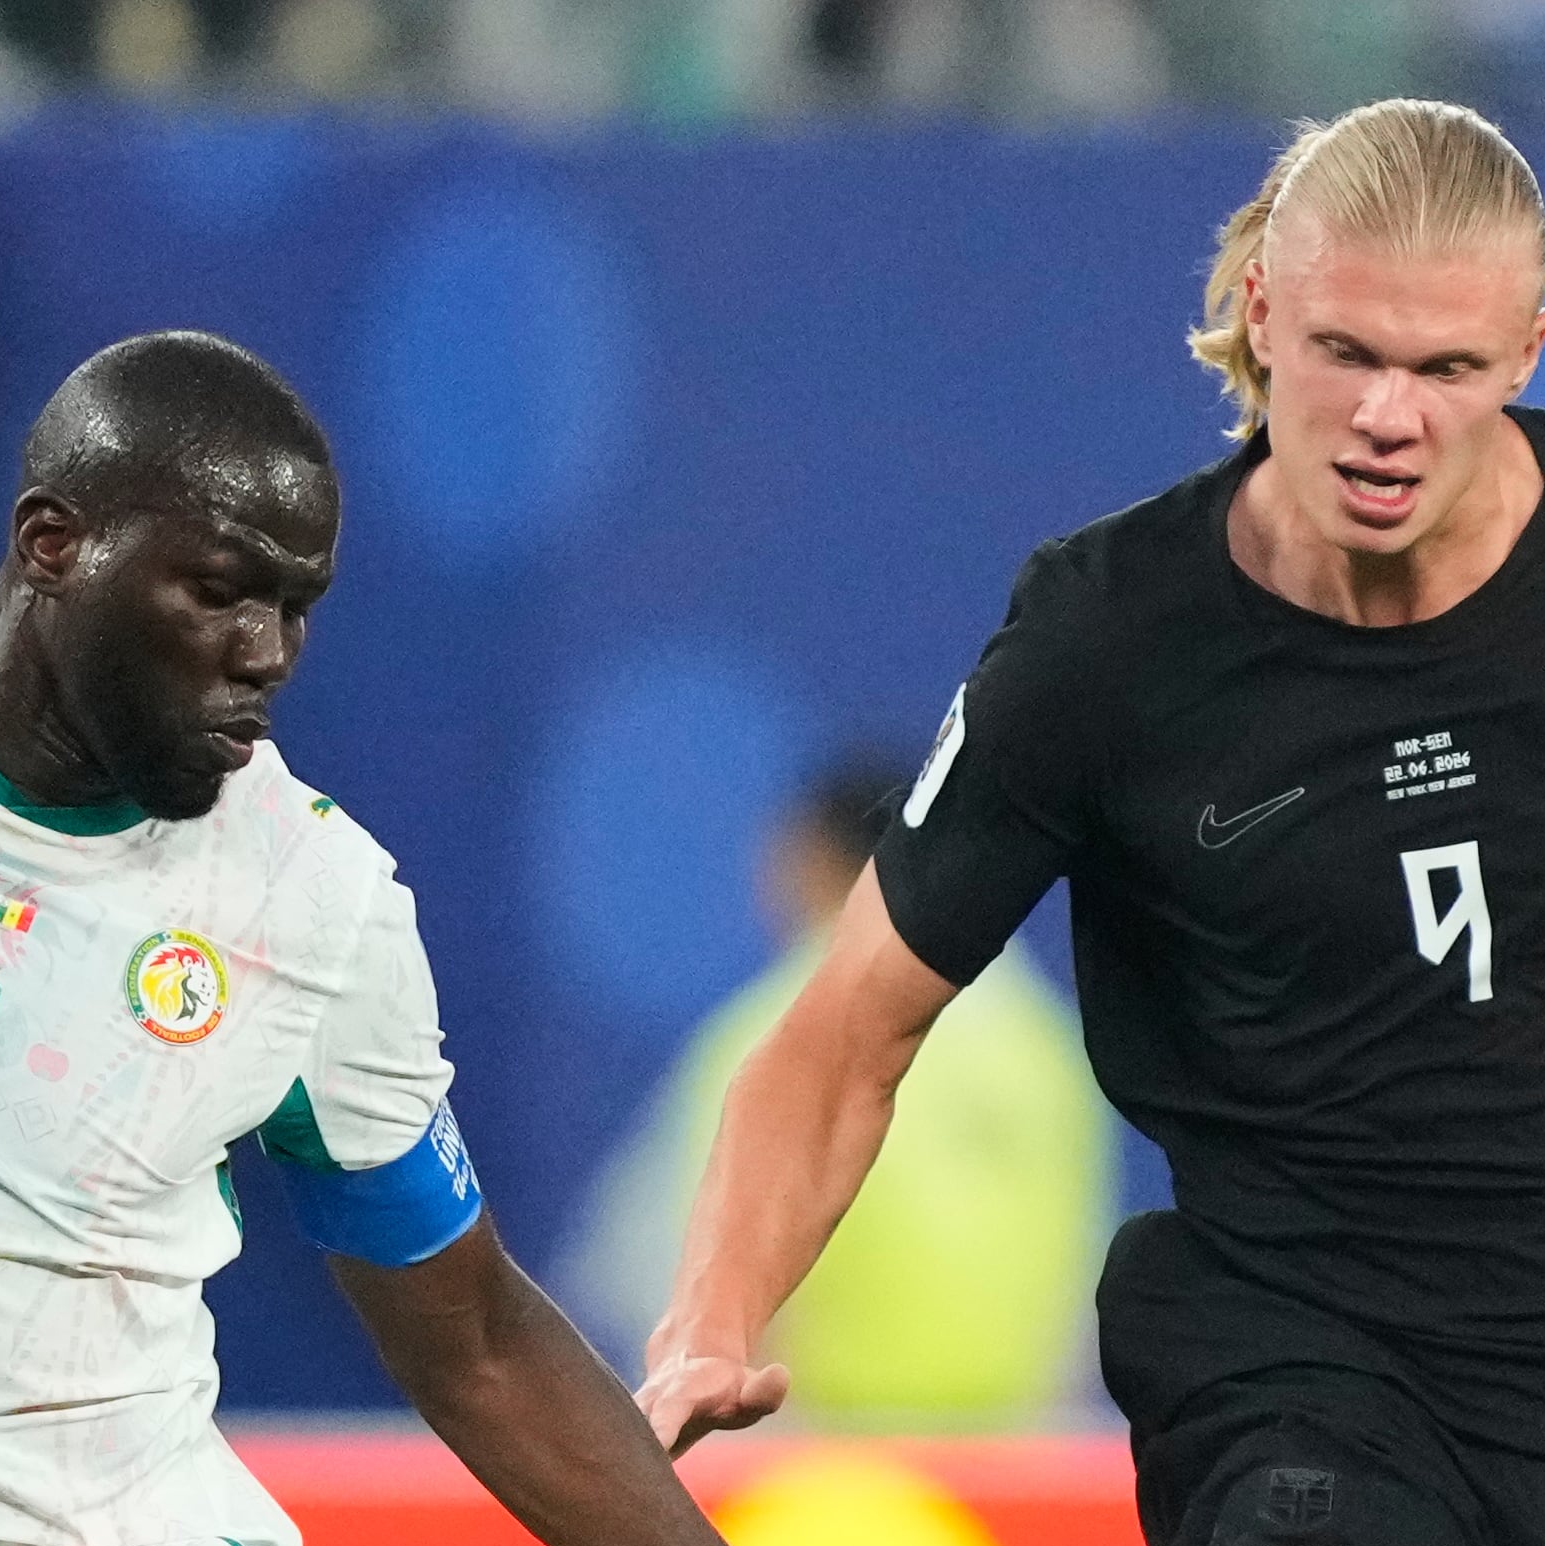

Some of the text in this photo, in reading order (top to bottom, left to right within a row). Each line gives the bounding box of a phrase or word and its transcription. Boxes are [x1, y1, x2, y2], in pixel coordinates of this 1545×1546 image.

[1395, 731, 1452, 758] NOR-SEN
[1384, 751, 1471, 784] 22.06.2026
[1400, 840, 1493, 1002] 9
